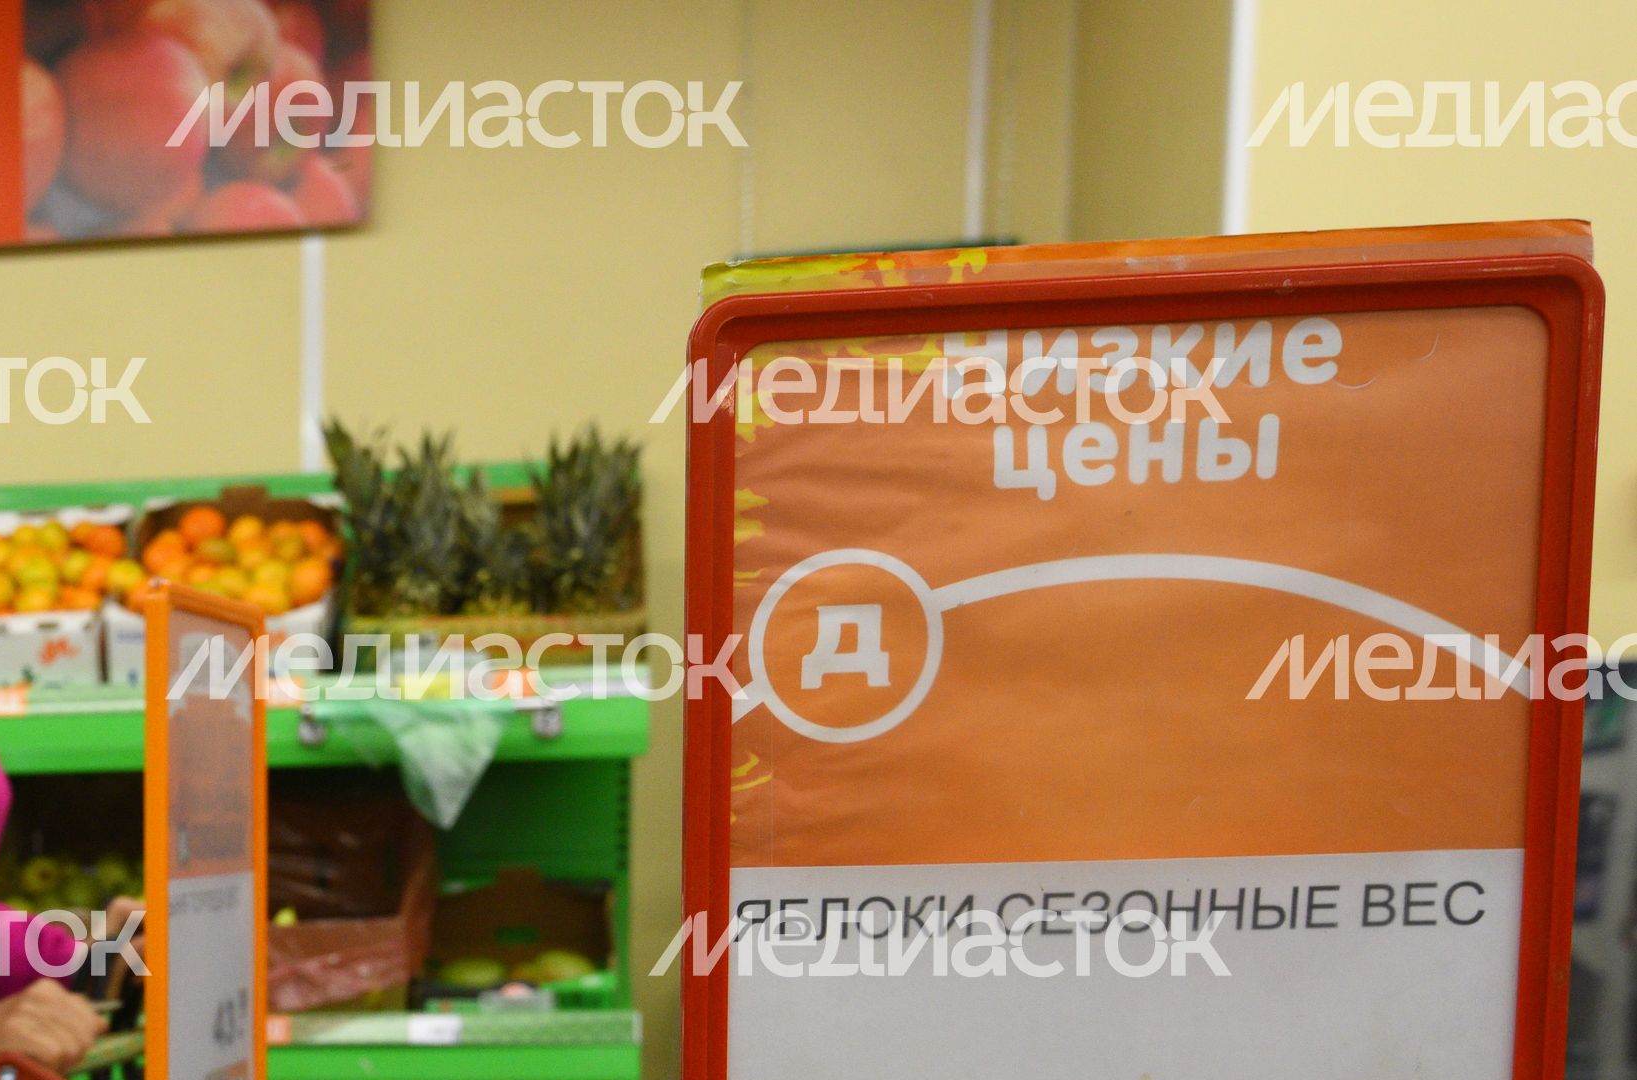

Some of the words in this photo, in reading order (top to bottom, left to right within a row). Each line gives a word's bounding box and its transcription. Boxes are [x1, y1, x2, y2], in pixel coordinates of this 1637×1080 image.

[994, 414, 1279, 500] цены
[733, 894, 976, 942] ЯБЛОКИ
[996, 885, 1340, 938] СЕЗОННЫЕ
[1362, 880, 1486, 927] ВЕС
